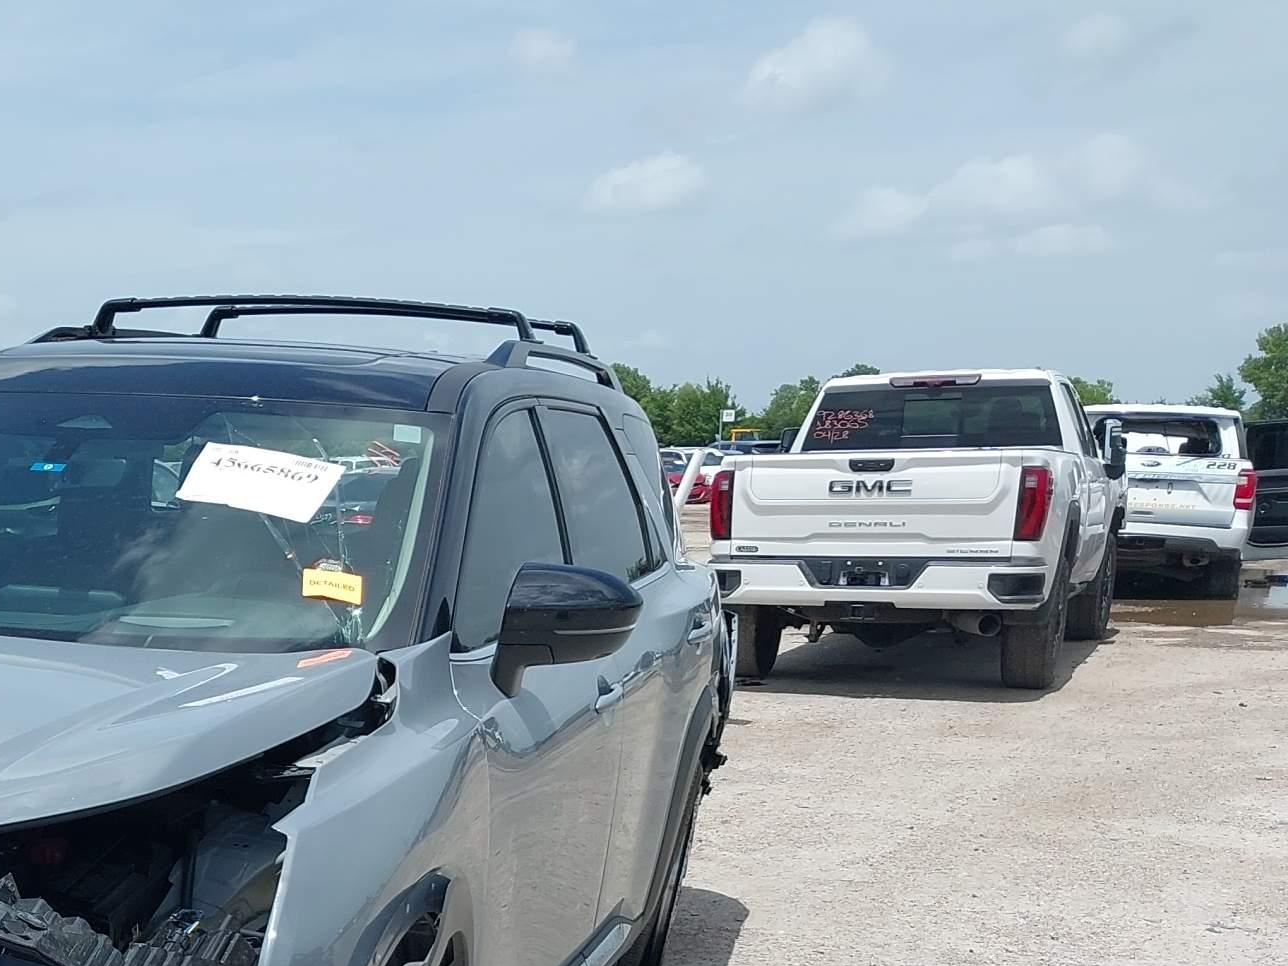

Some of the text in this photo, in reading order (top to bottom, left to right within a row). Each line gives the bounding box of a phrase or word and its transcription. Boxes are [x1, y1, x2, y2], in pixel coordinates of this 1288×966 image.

[1206, 462, 1237, 470] 228
[828, 480, 912, 497] GMC
[309, 579, 355, 592] DETAILED
